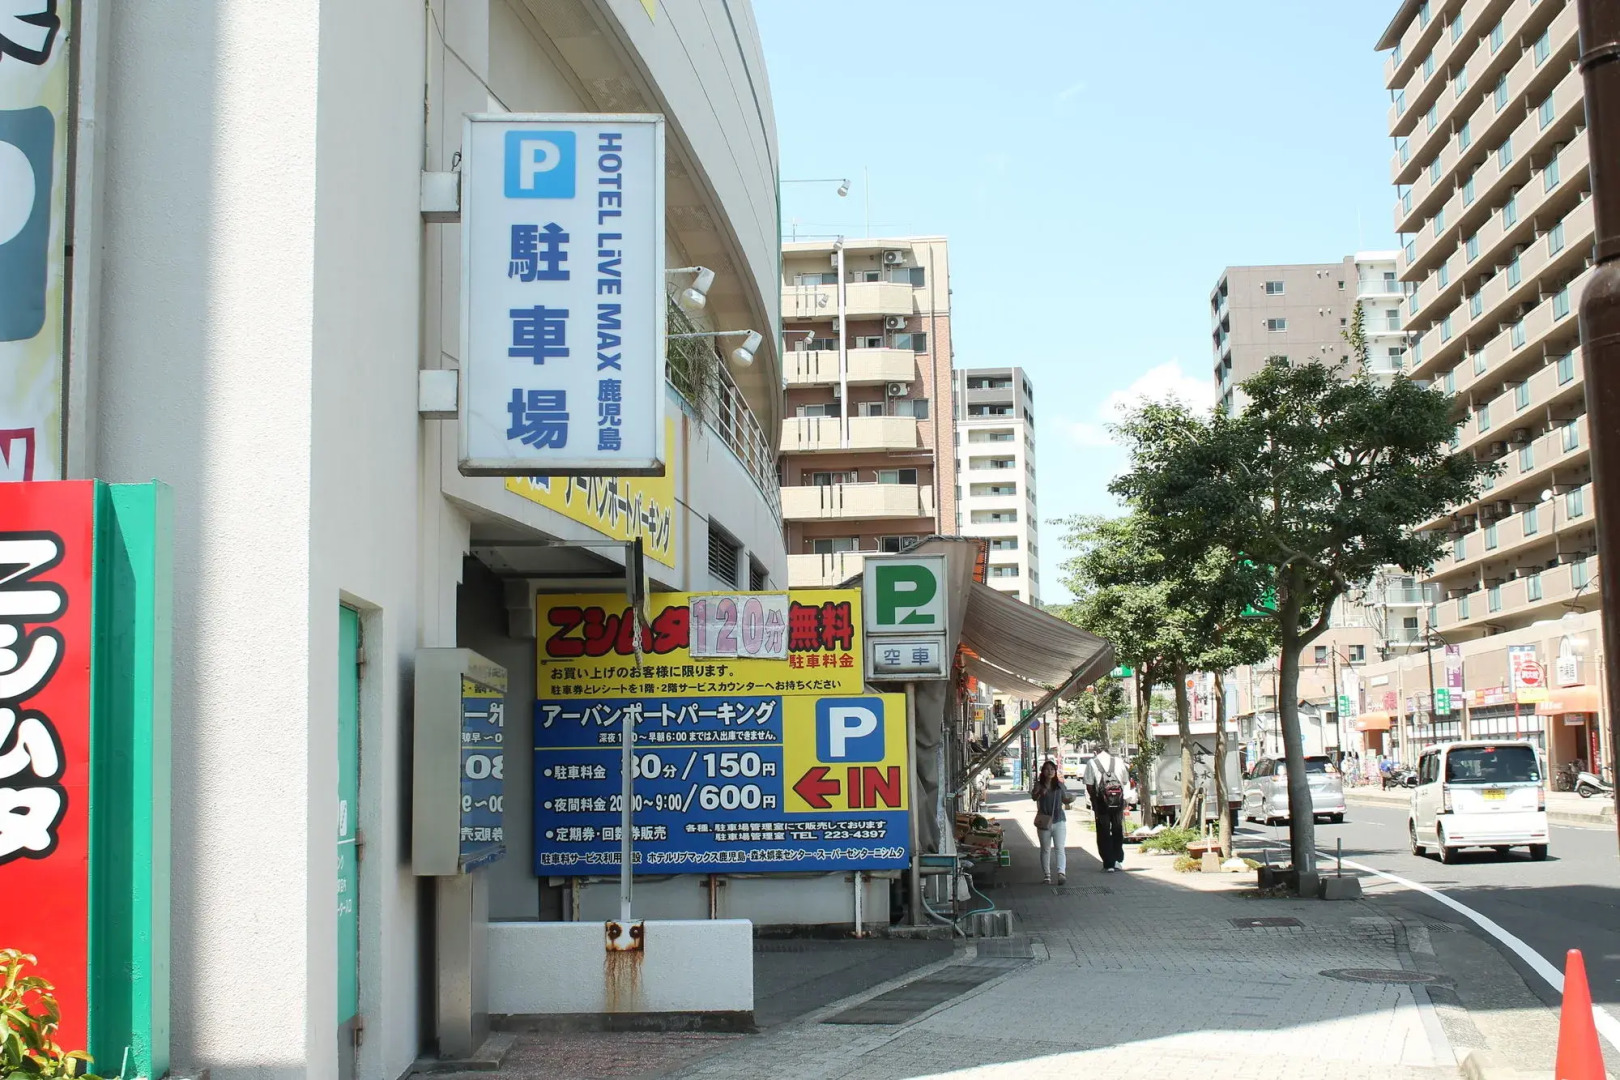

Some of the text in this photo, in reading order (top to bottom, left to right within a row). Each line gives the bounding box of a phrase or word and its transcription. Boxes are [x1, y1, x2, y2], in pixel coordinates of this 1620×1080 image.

[520, 140, 561, 190] P
[598, 133, 622, 225] HOTEL
[507, 222, 570, 450] 駐車場
[597, 304, 621, 371] MAX
[597, 379, 622, 451] 鹿児島
[693, 598, 785, 655] 120分
[788, 601, 854, 652] 無料
[789, 654, 854, 669] 駐車料金
[883, 648, 930, 666] 空車
[542, 701, 776, 728] アーバンポートパーキング
[829, 707, 878, 757] P
[554, 765, 606, 780] 駐車料金
[847, 766, 902, 808] IN
[554, 798, 606, 812] 夜間料金
[715, 830, 886, 841] 駐車場管理室 TEL 223-4397
[541, 851, 642, 865] 駐車料サービス利用設
